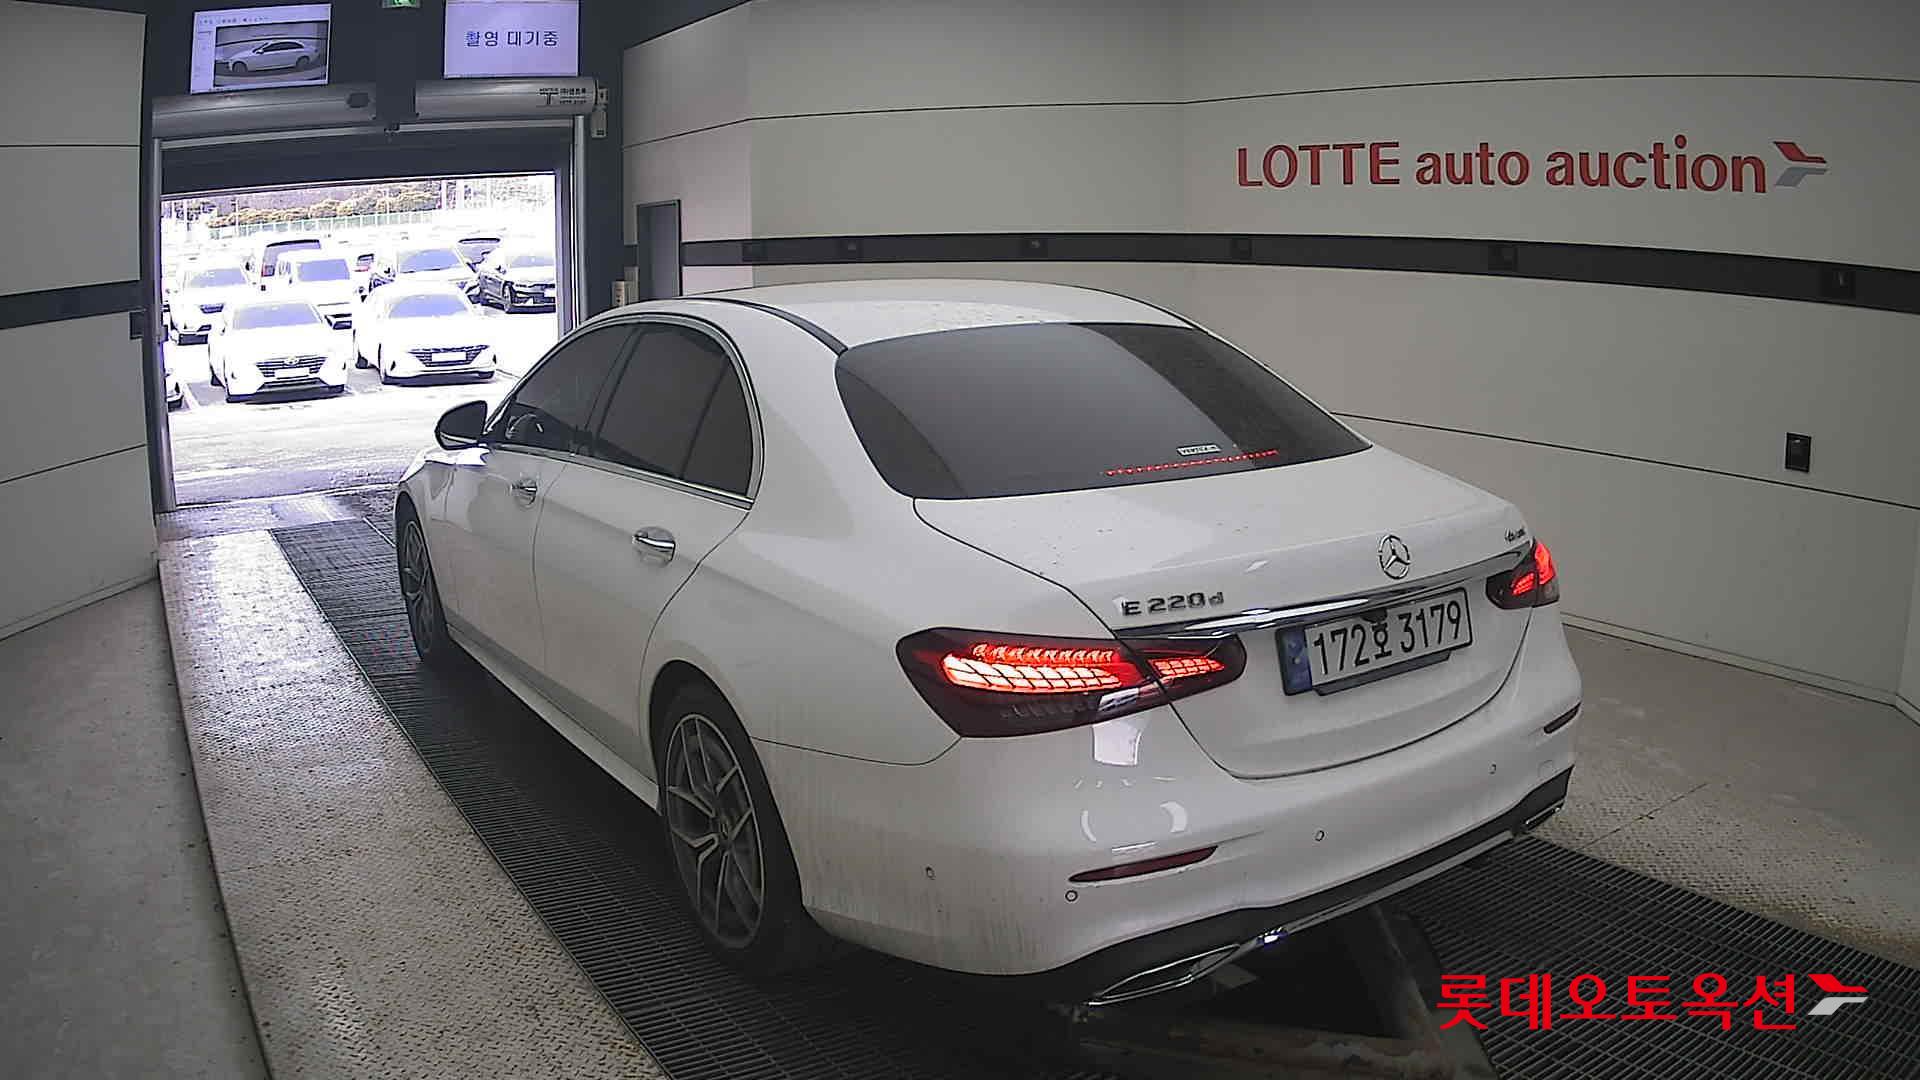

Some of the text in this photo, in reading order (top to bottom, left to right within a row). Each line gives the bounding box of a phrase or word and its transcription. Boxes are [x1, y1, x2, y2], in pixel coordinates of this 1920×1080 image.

[507, 31, 559, 47] 대기중
[1236, 134, 1767, 194] LOTTE auto auction
[1121, 600, 1142, 616] E
[1313, 600, 1461, 675] 172호 3179
